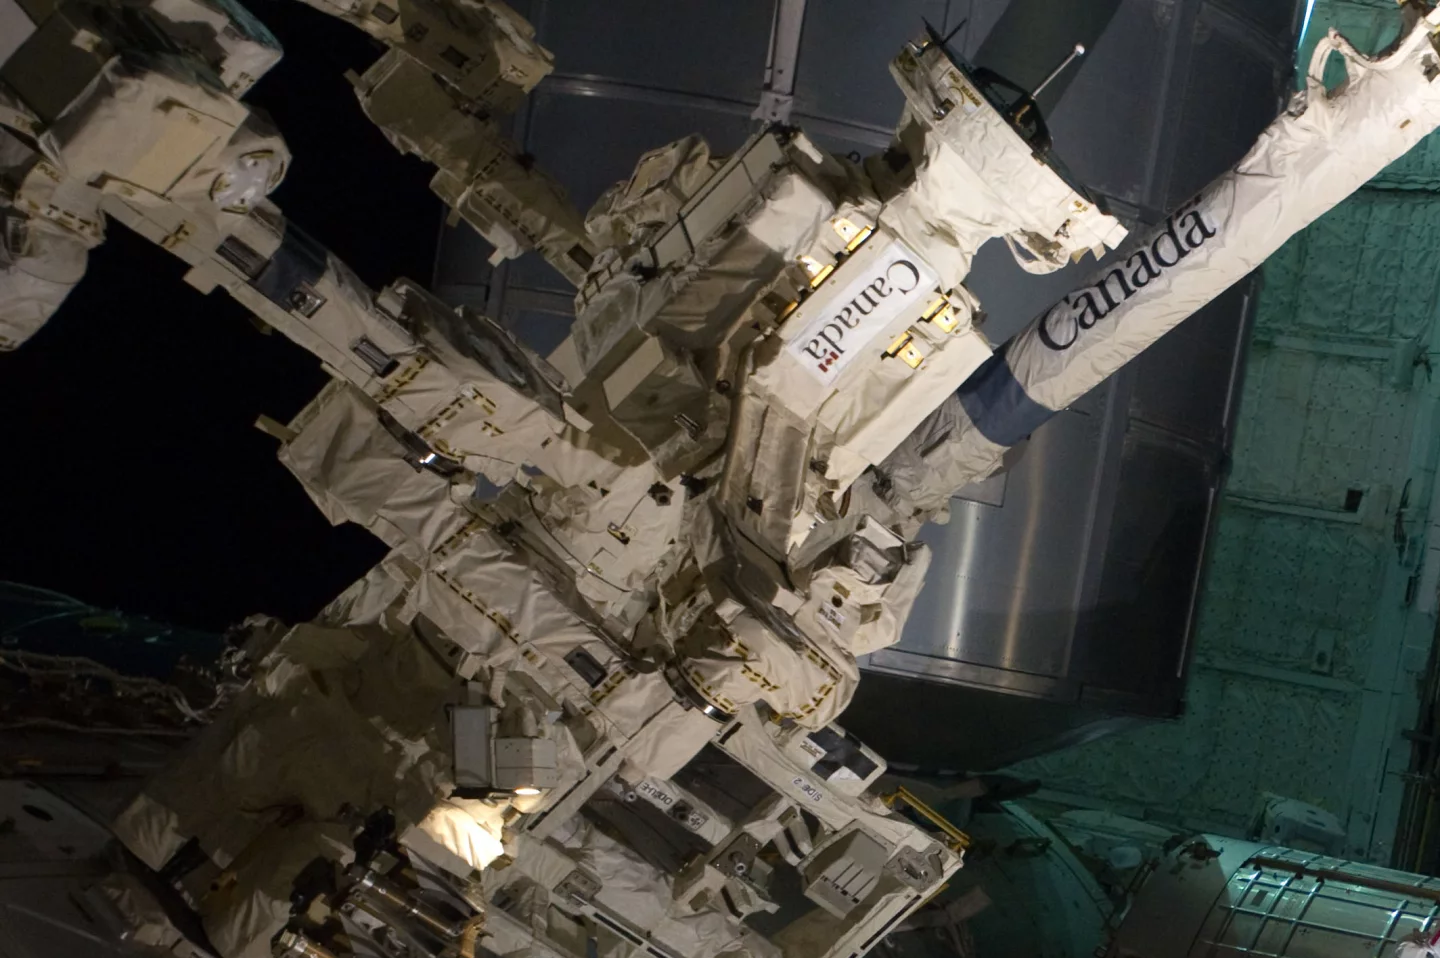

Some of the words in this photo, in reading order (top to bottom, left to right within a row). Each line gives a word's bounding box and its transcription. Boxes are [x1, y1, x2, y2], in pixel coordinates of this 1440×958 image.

[802, 259, 920, 360] Canada
[1038, 210, 1216, 350] Canada
[800, 784, 823, 802] SIDE
